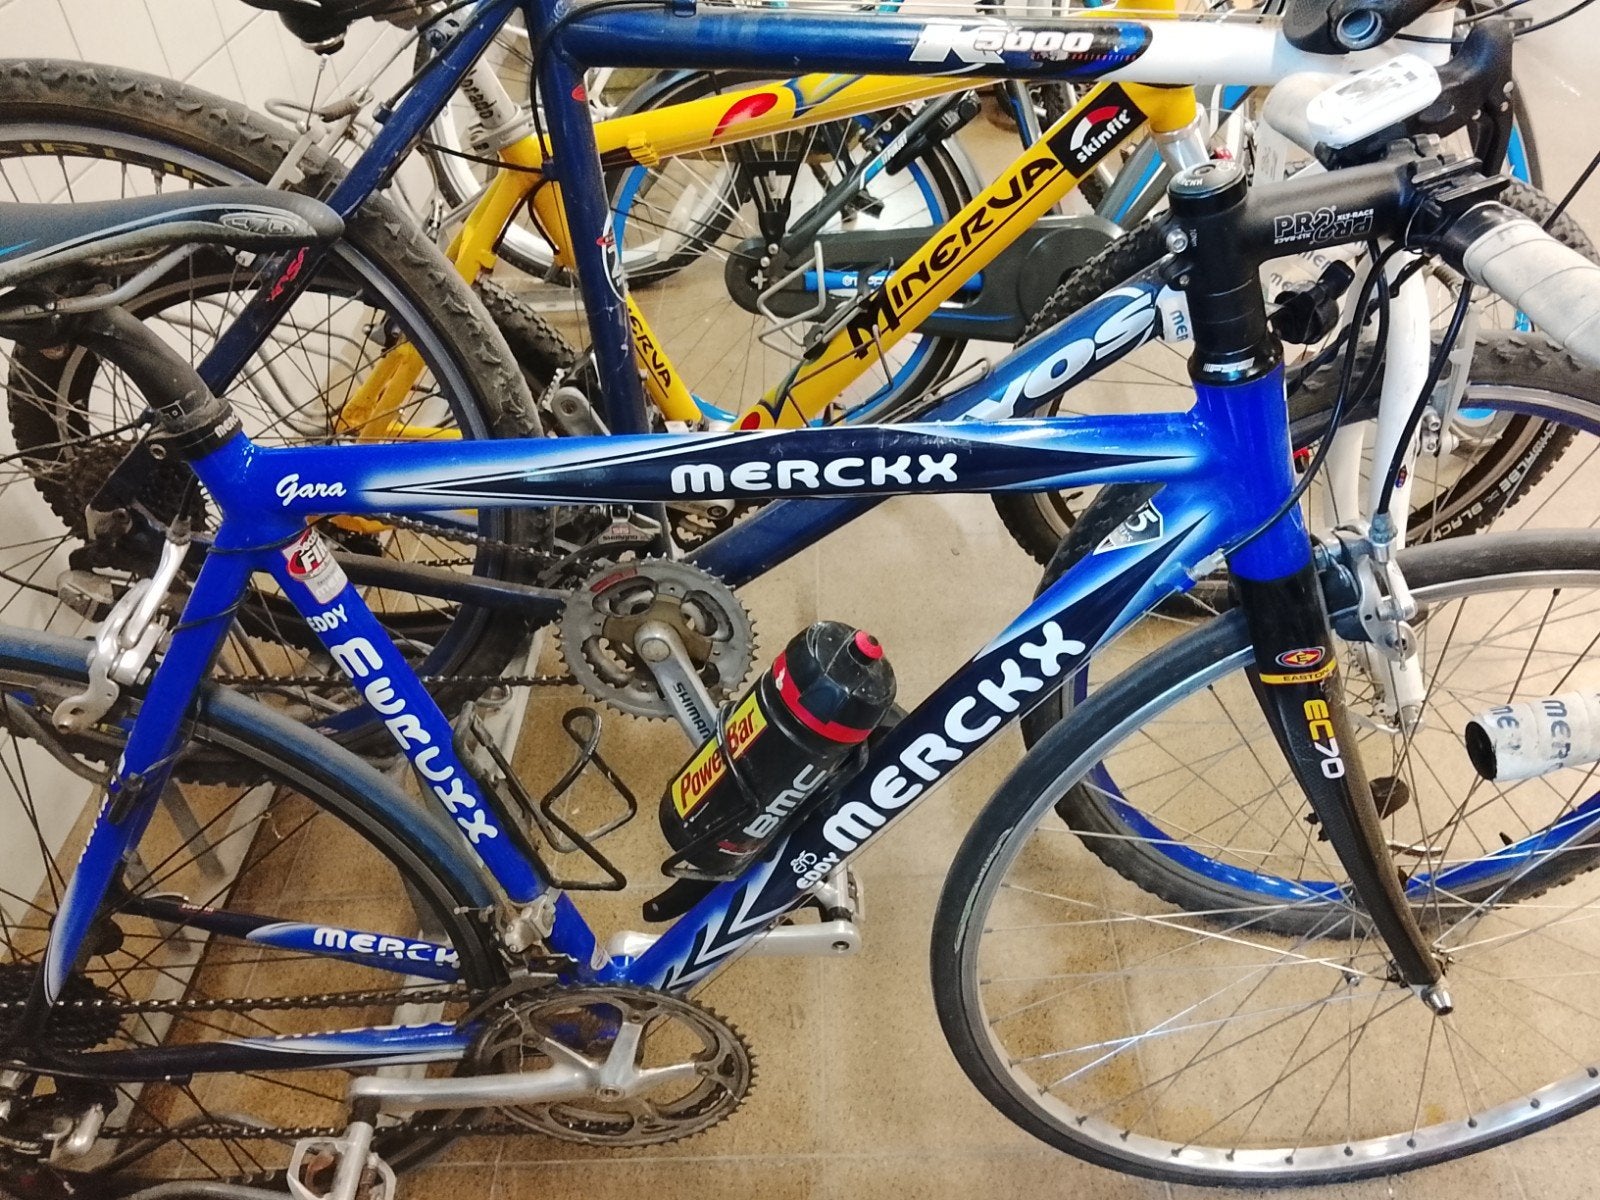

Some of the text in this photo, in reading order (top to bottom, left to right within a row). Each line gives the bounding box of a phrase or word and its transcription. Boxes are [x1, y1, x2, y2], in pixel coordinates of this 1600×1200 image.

[1077, 108, 1132, 164] skinfit
[628, 307, 672, 388] ERVA
[276, 473, 347, 506] Gara
[670, 453, 958, 494] MERCKX
[1503, 421, 1561, 493] CHWALBE
[672, 682, 713, 739] SHIMAN
[1283, 668, 1330, 682] EASTON
[306, 603, 498, 844] EDDY MERCKX
[680, 708, 755, 810] PoweBar
[796, 852, 840, 889] EDDY
[822, 621, 1086, 852] MERCKX
[1303, 699, 1345, 779] EC70
[743, 763, 827, 839] BMC
[313, 928, 460, 969] MERCK
